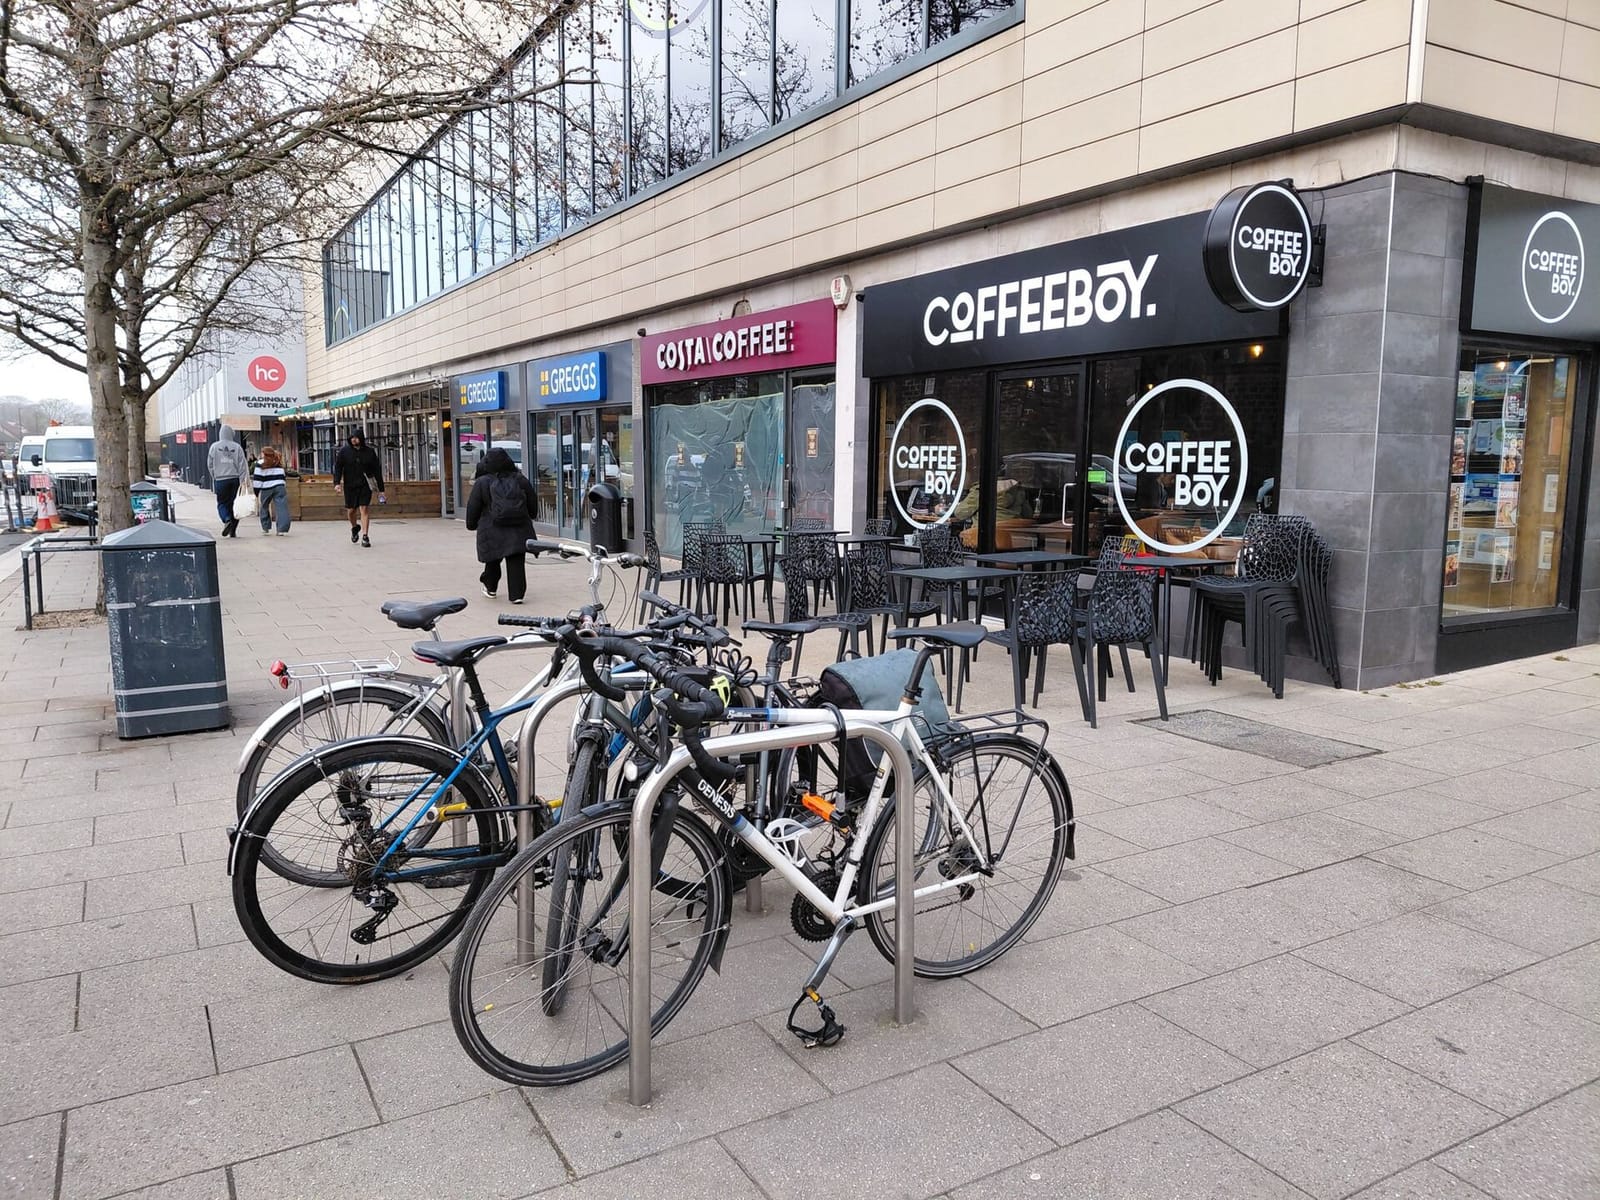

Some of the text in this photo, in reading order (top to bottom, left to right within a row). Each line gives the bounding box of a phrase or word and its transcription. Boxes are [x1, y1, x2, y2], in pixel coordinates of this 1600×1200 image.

[1239, 225, 1303, 255] COFFEE
[1529, 249, 1579, 276] COFFEE
[656, 319, 791, 371] COSTA COFFEE
[255, 364, 279, 381] hc
[551, 361, 597, 395] GREGGS
[238, 395, 298, 403] HEADINGLEY
[467, 379, 497, 404] GREGGS
[896, 445, 958, 471] COFFEE
[1125, 441, 1231, 474] COFFEE
[697, 778, 736, 819] GENESIS
